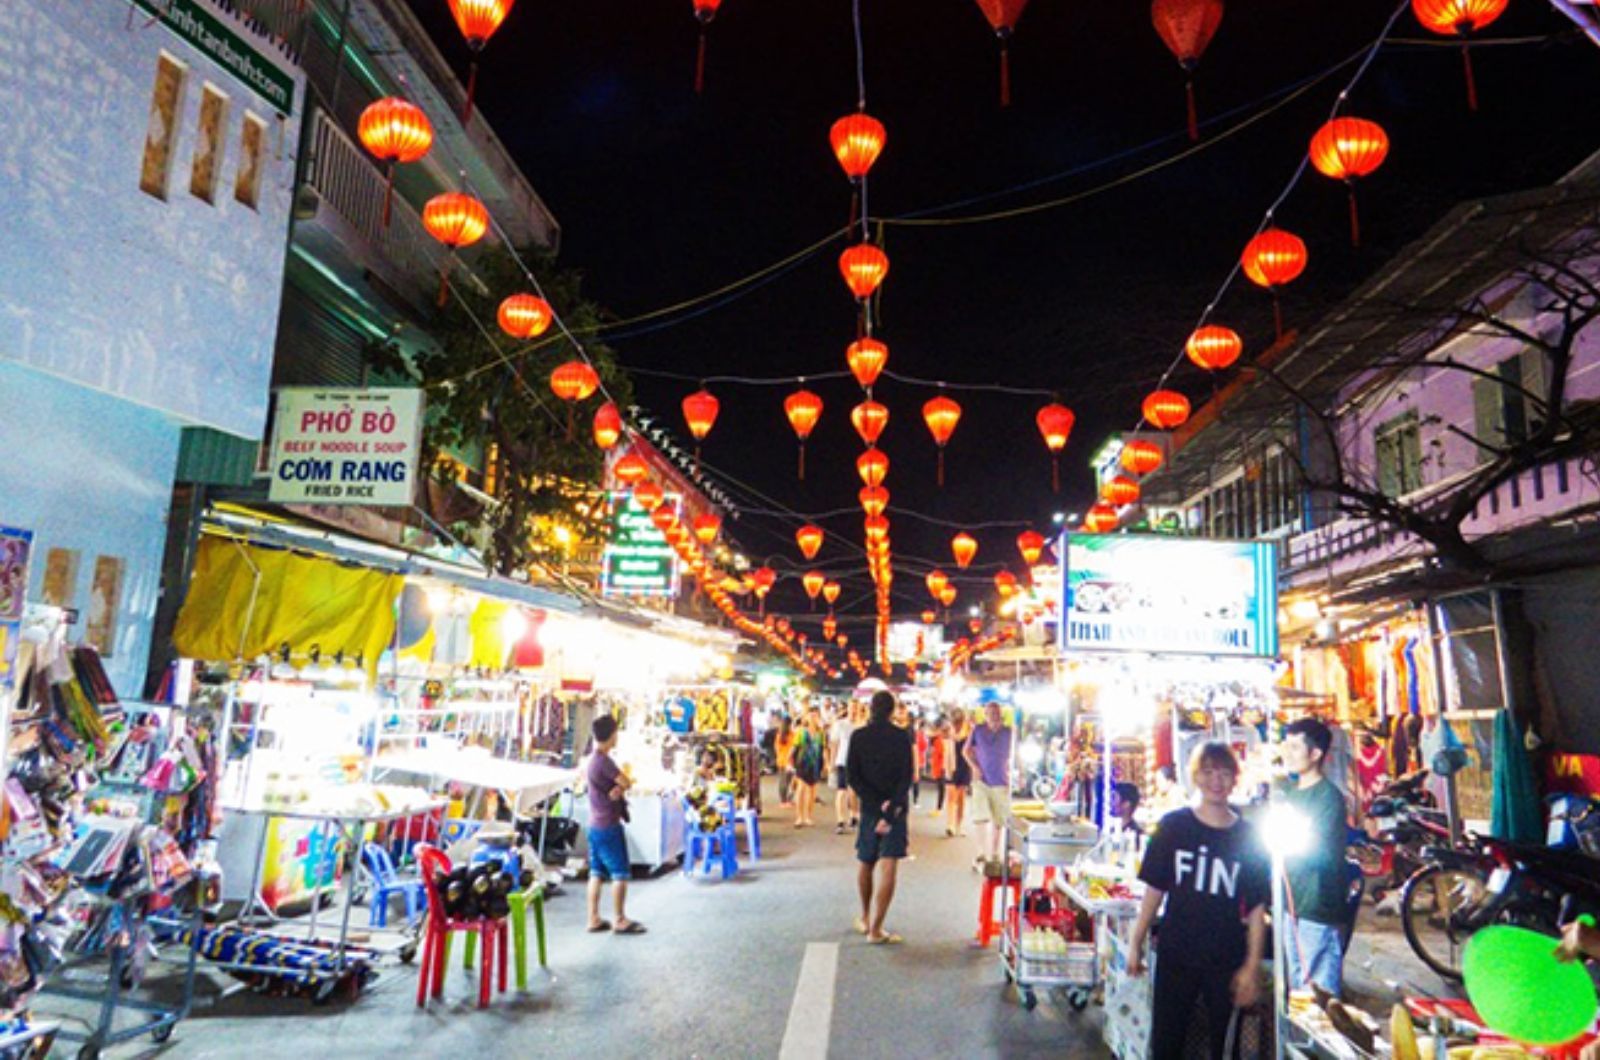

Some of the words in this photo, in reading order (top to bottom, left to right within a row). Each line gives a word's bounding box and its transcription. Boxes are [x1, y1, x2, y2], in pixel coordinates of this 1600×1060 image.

[301, 403, 355, 433] PHỞ
[361, 406, 396, 434] BÒ
[283, 441, 316, 453] BEEF
[320, 441, 369, 453] NOODLE
[374, 442, 407, 453] SOUP
[279, 457, 333, 481] CƠM
[340, 460, 406, 482] RANG
[304, 484, 343, 497] FRIED
[345, 485, 375, 497] RICE
